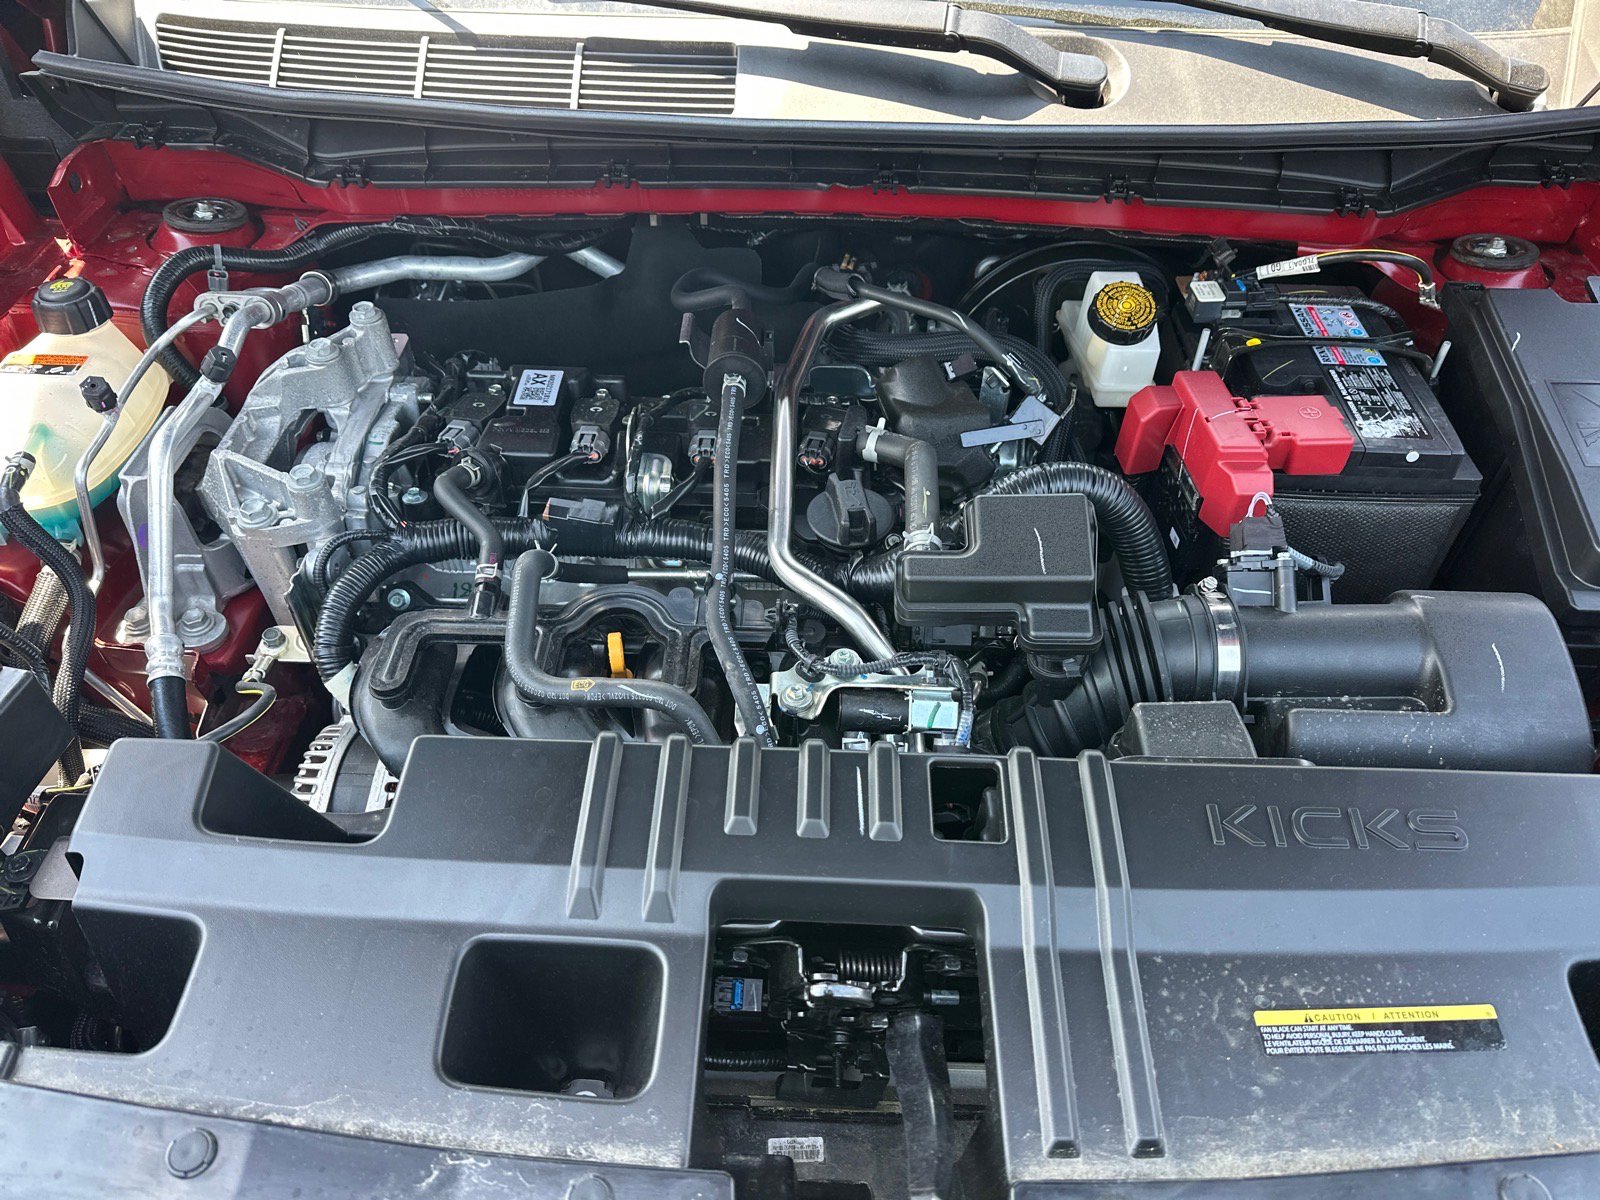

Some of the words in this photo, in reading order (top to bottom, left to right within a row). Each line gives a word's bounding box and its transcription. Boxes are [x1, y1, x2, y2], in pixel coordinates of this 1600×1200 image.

[530, 372, 548, 386] AX
[1206, 803, 1469, 851] KICKS
[1314, 1013, 1361, 1021] CAUTION
[1384, 1010, 1440, 1020] ATTENTION
